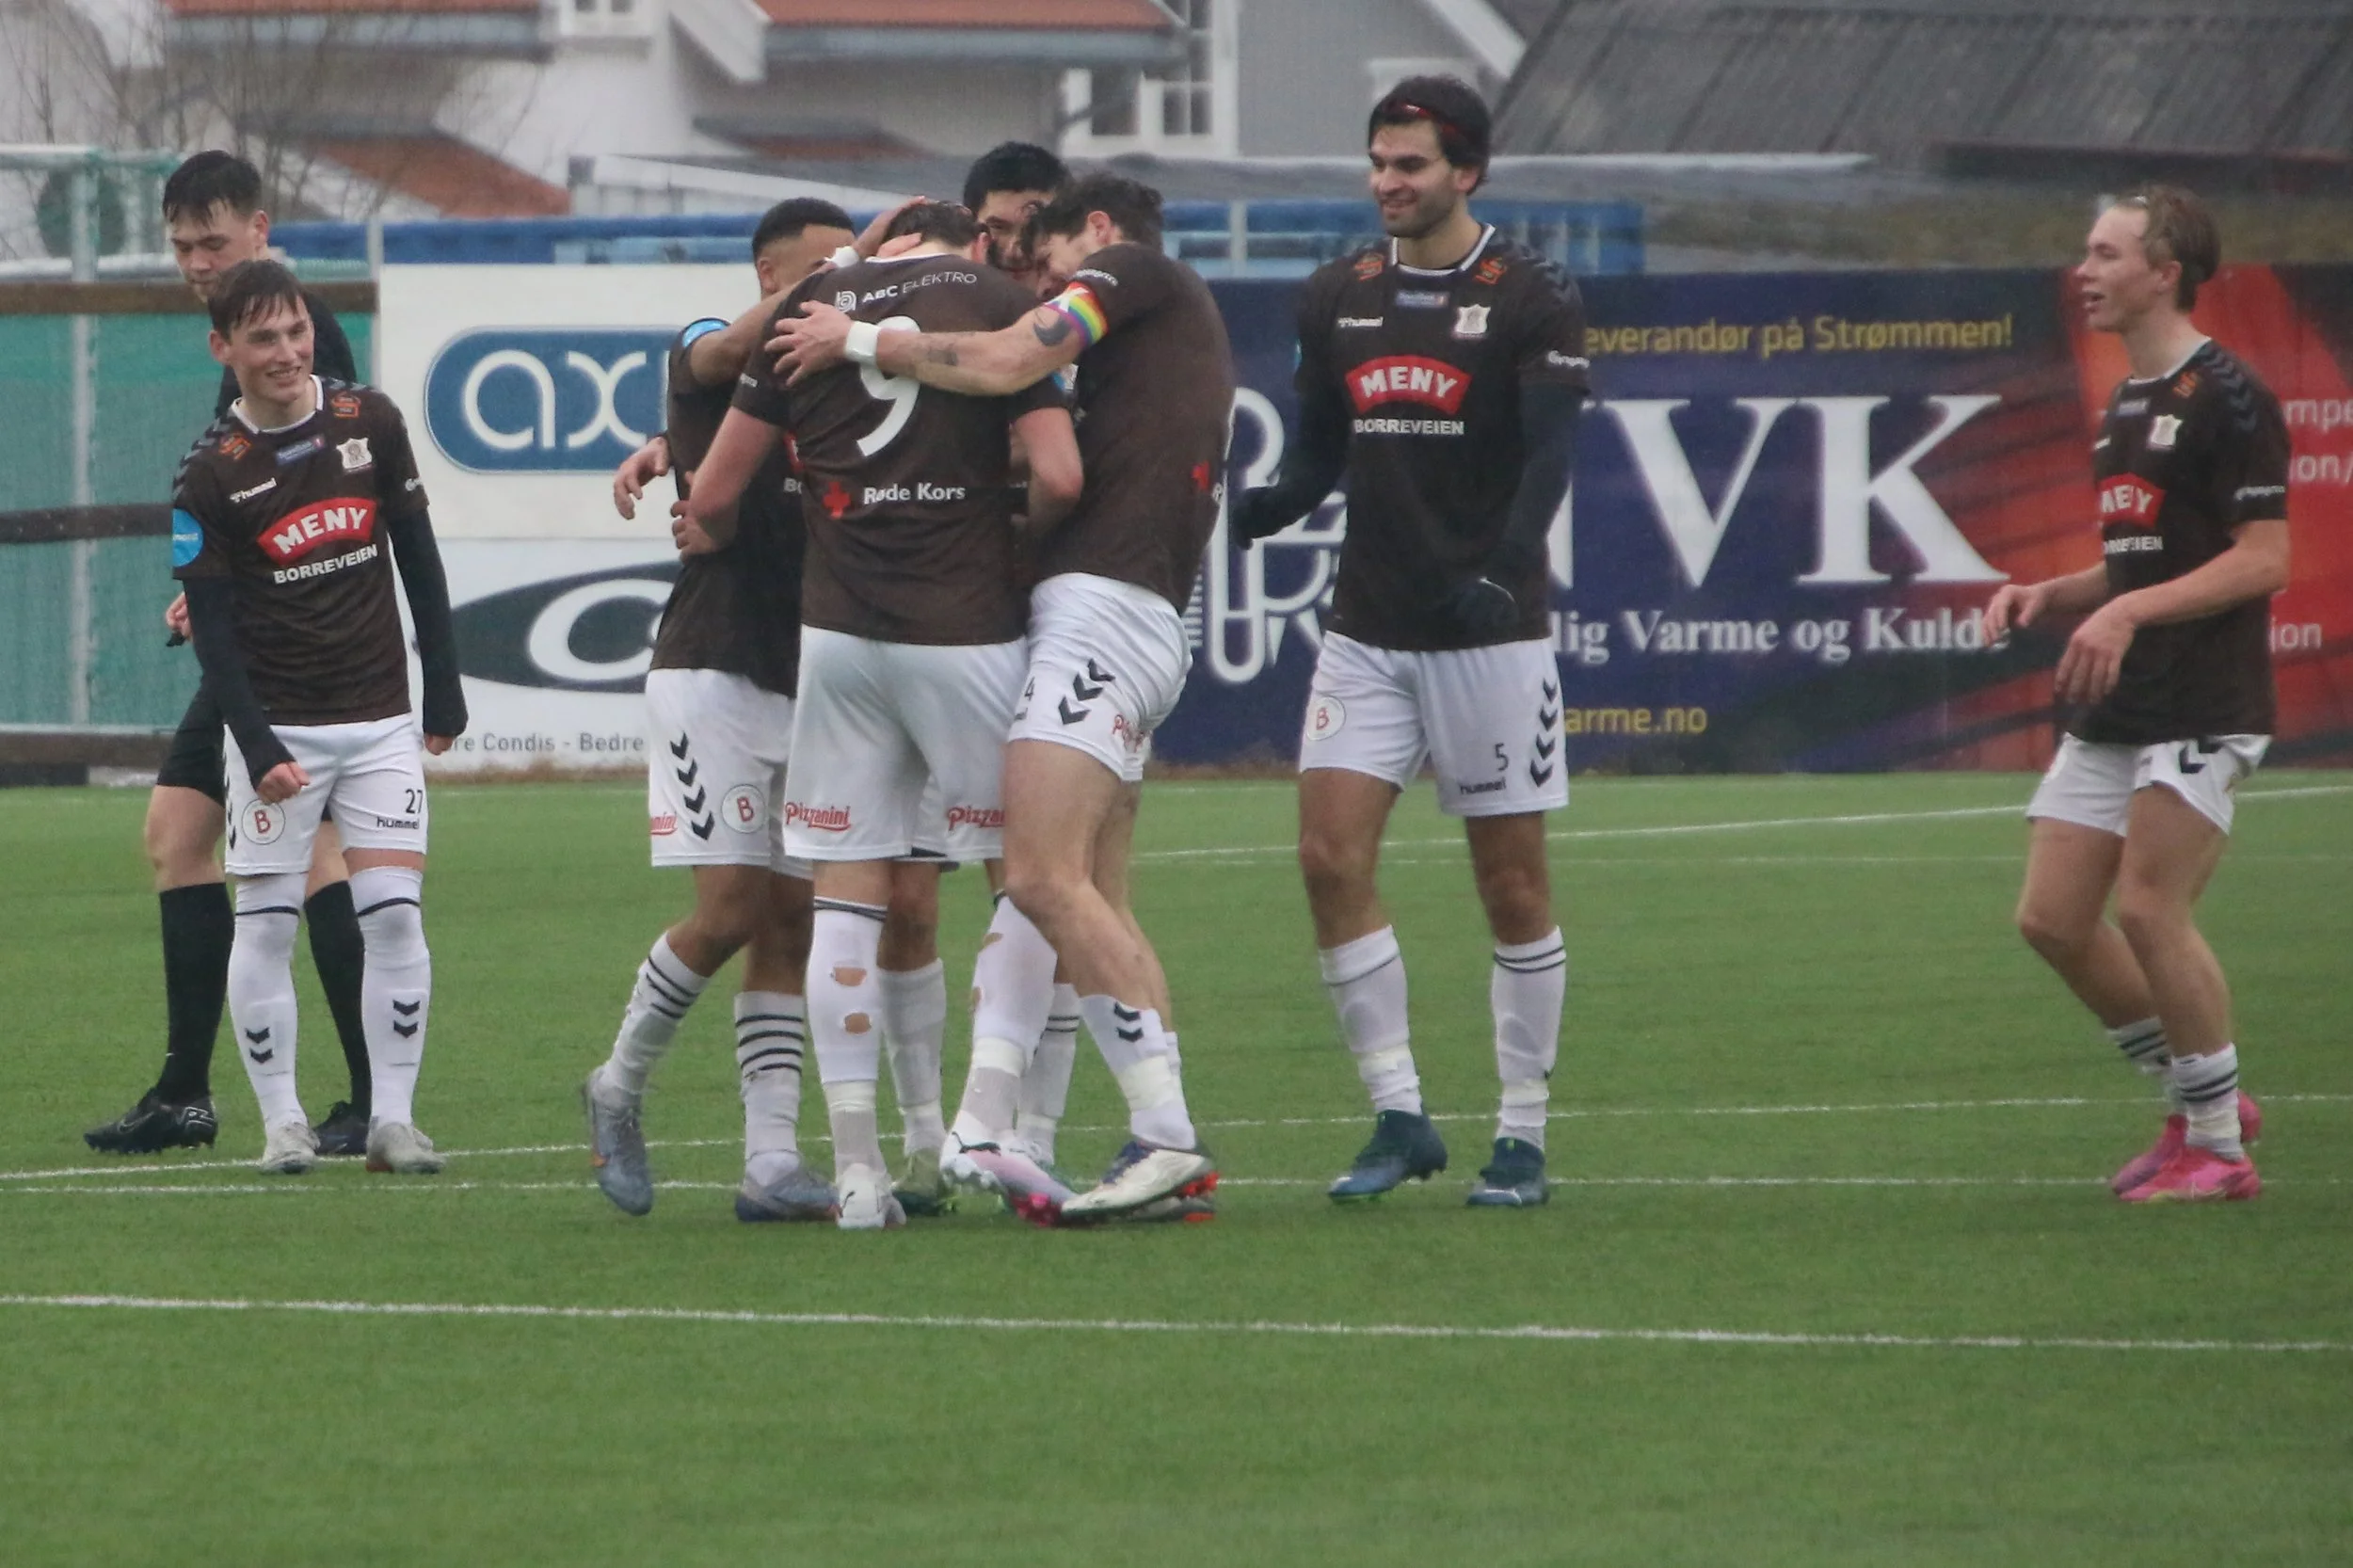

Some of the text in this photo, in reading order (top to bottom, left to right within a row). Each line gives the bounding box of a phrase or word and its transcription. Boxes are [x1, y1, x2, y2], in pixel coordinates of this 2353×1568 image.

[862, 271, 977, 303] ABC ELEKTRO
[1585, 314, 2012, 359] everandør på Strømmen!
[1361, 366, 1457, 398] MENY
[1353, 418, 1465, 435] BORREVEIEN
[864, 482, 966, 504] Røde Kors
[1545, 394, 2010, 590] VK
[273, 507, 367, 555] MENY
[273, 543, 377, 584] BORREVEIEN
[1621, 610, 1779, 652] Varme
[1794, 618, 1851, 664] og
[1317, 708, 1328, 731] B
[1565, 706, 1708, 733] arme.no
[483, 732, 555, 752] Condis
[579, 731, 645, 752] Bedre
[1495, 743, 1509, 772] 5
[1460, 777, 1506, 796] hummel
[405, 789, 424, 814] 27
[737, 796, 754, 824] B
[254, 809, 271, 834] B
[376, 816, 420, 830] hummel
[785, 801, 852, 831] Pizzanini
